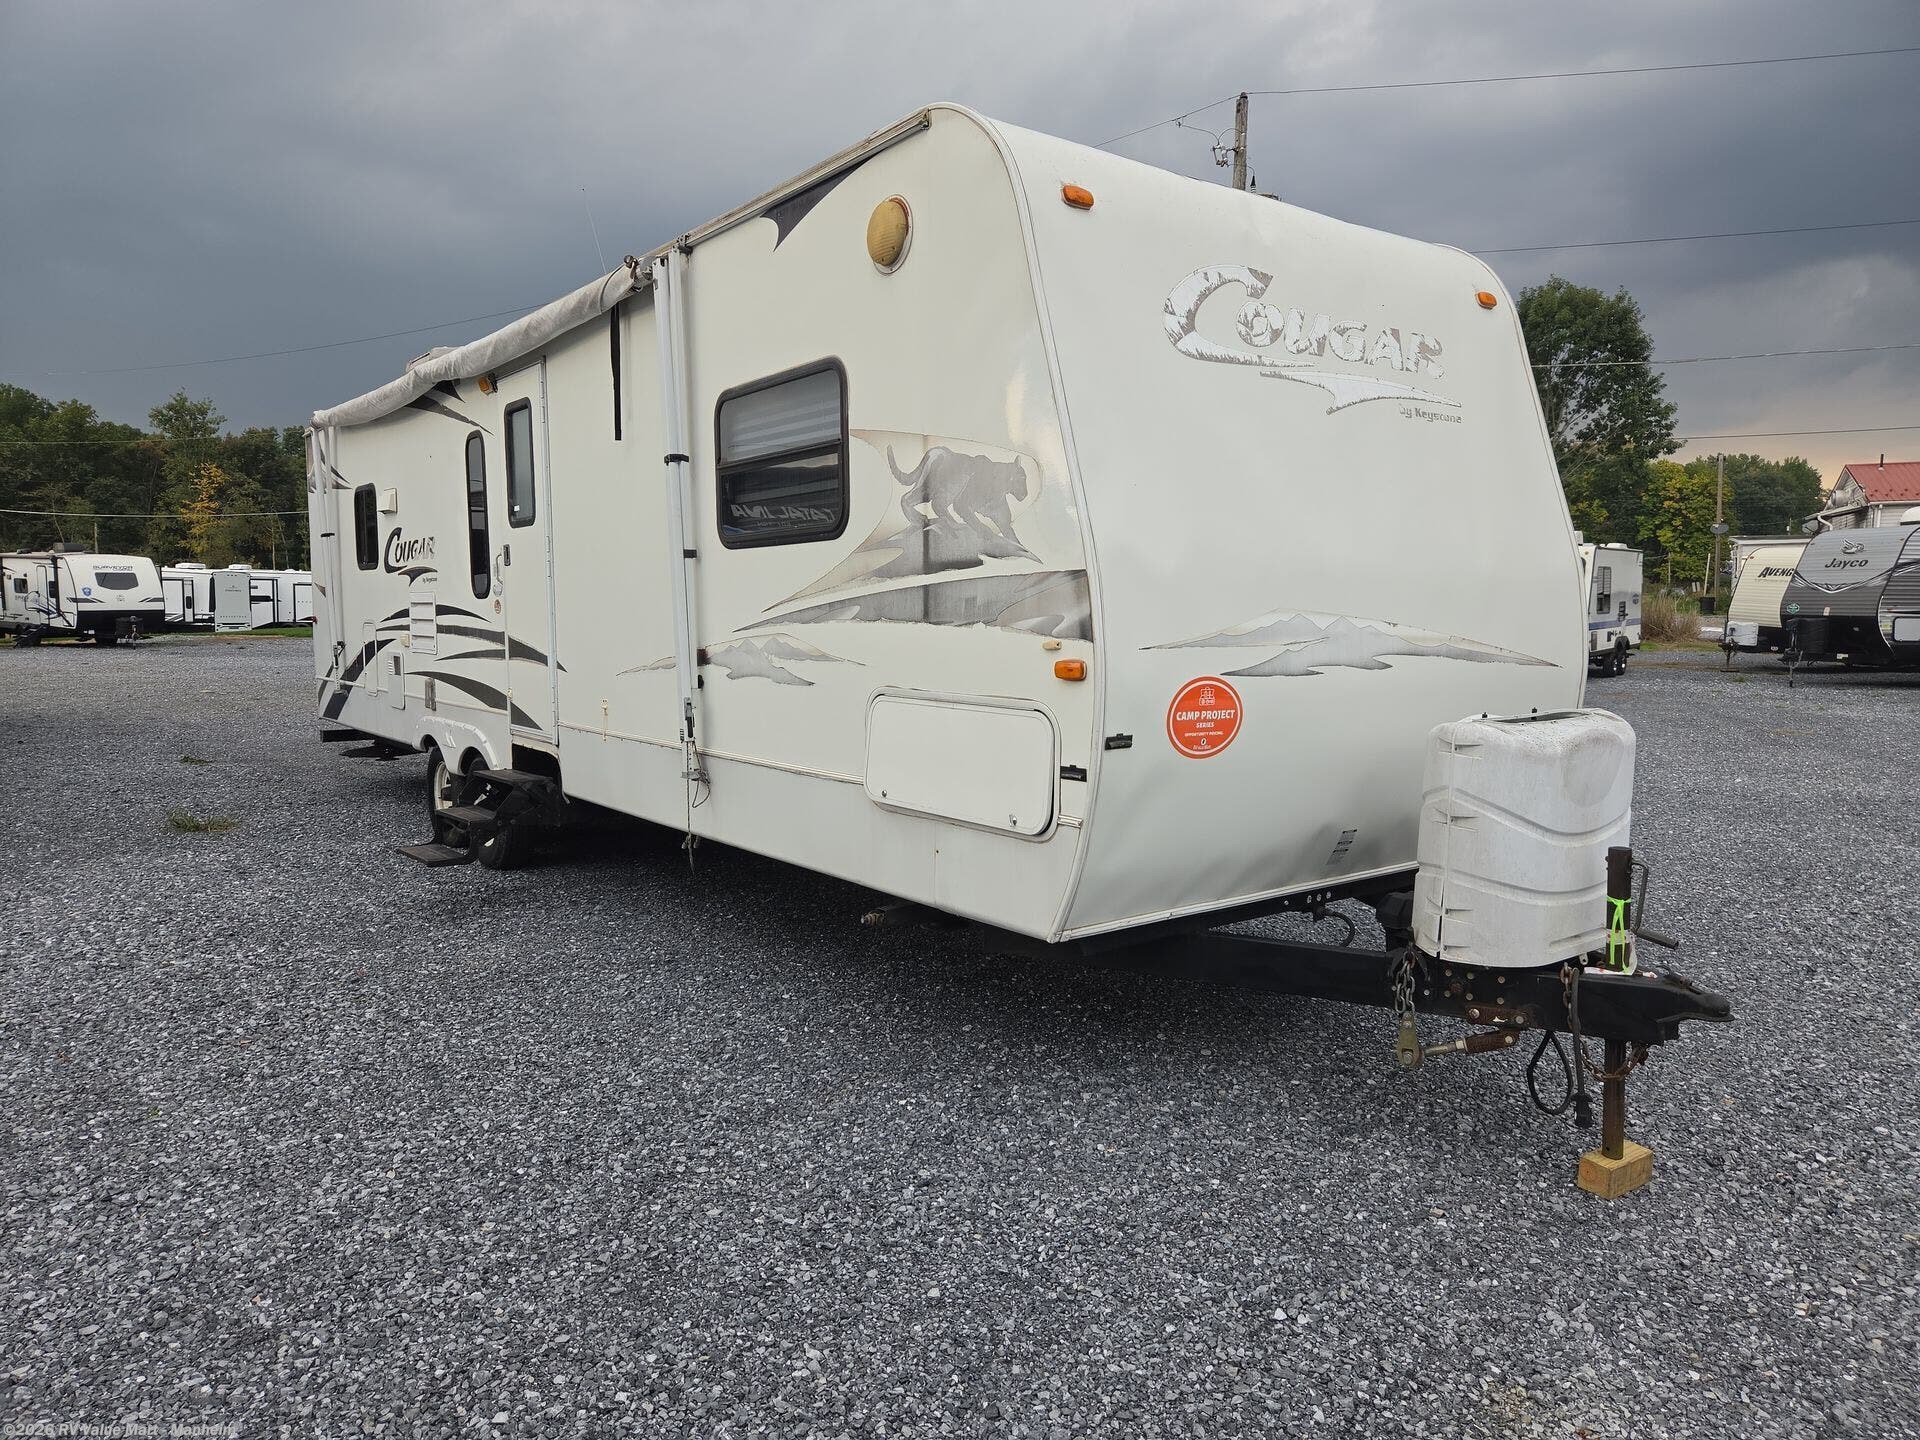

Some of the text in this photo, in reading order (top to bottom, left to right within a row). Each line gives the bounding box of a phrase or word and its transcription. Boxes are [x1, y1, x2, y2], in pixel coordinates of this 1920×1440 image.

[1161, 264, 1446, 380] COUGAR
[384, 526, 435, 574] COUGAR
[1824, 558, 1869, 570] Jayco
[1176, 709, 1236, 720] CAMP PROJECT
